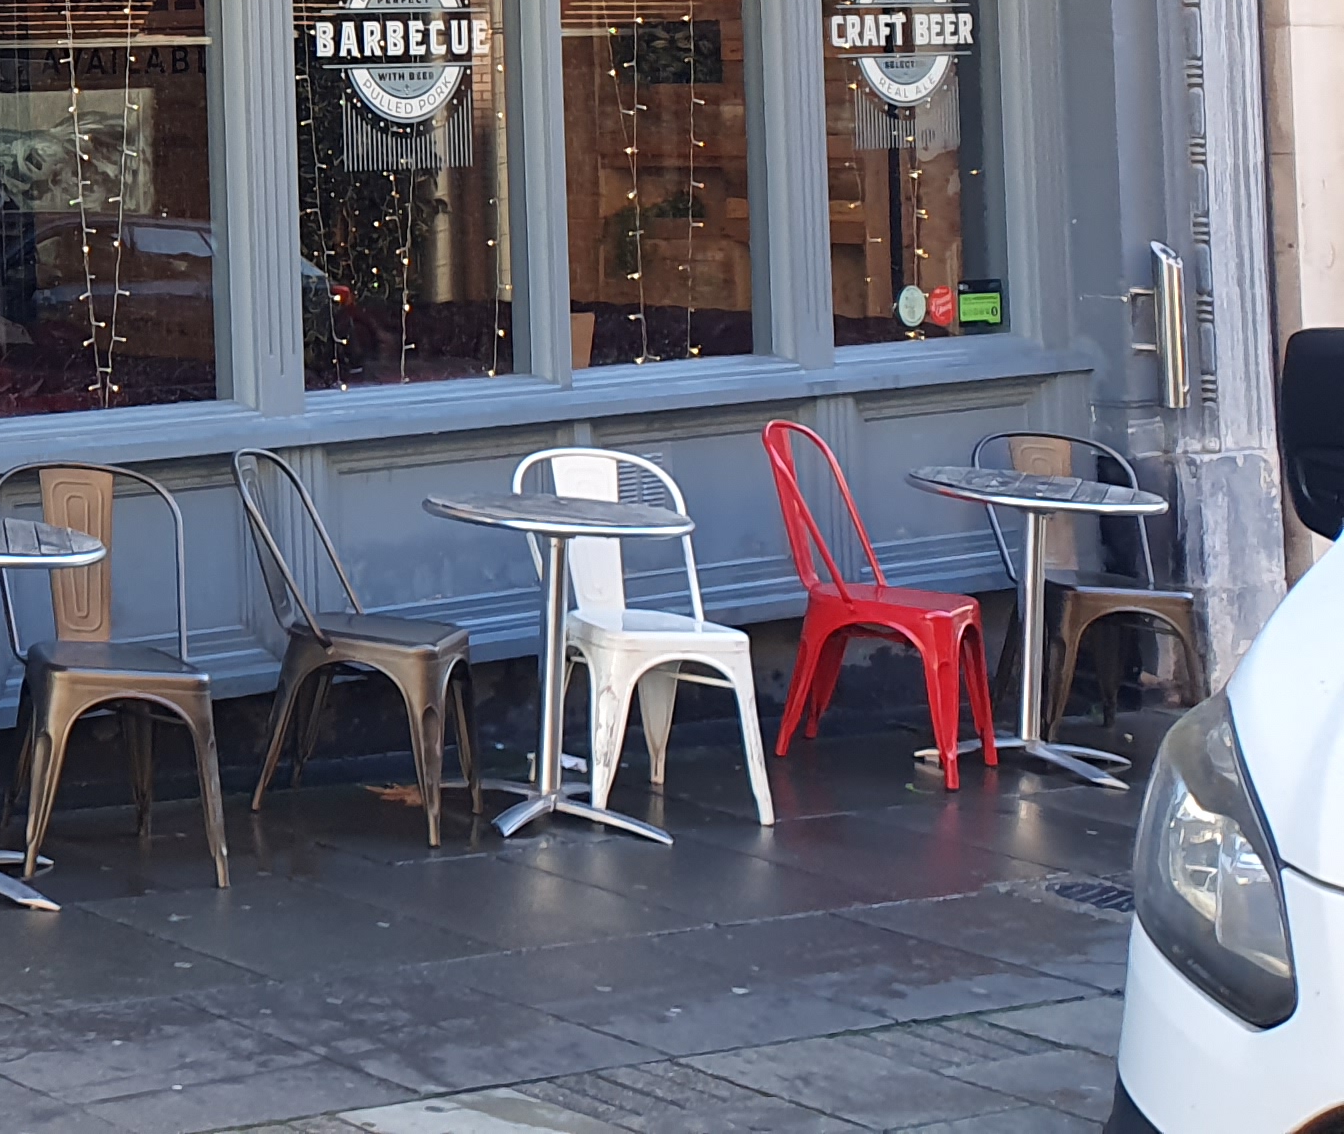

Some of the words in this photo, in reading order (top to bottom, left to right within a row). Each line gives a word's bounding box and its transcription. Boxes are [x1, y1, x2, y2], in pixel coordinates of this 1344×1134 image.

[315, 20, 491, 56] BARBECUE
[831, 14, 907, 46] CRAFT
[914, 13, 974, 45] BEER
[378, 72, 404, 81] WITH
[878, 78, 908, 97] REAL
[915, 76, 936, 95] ALE
[362, 79, 413, 114] PULLED
[419, 77, 451, 111] PORK
